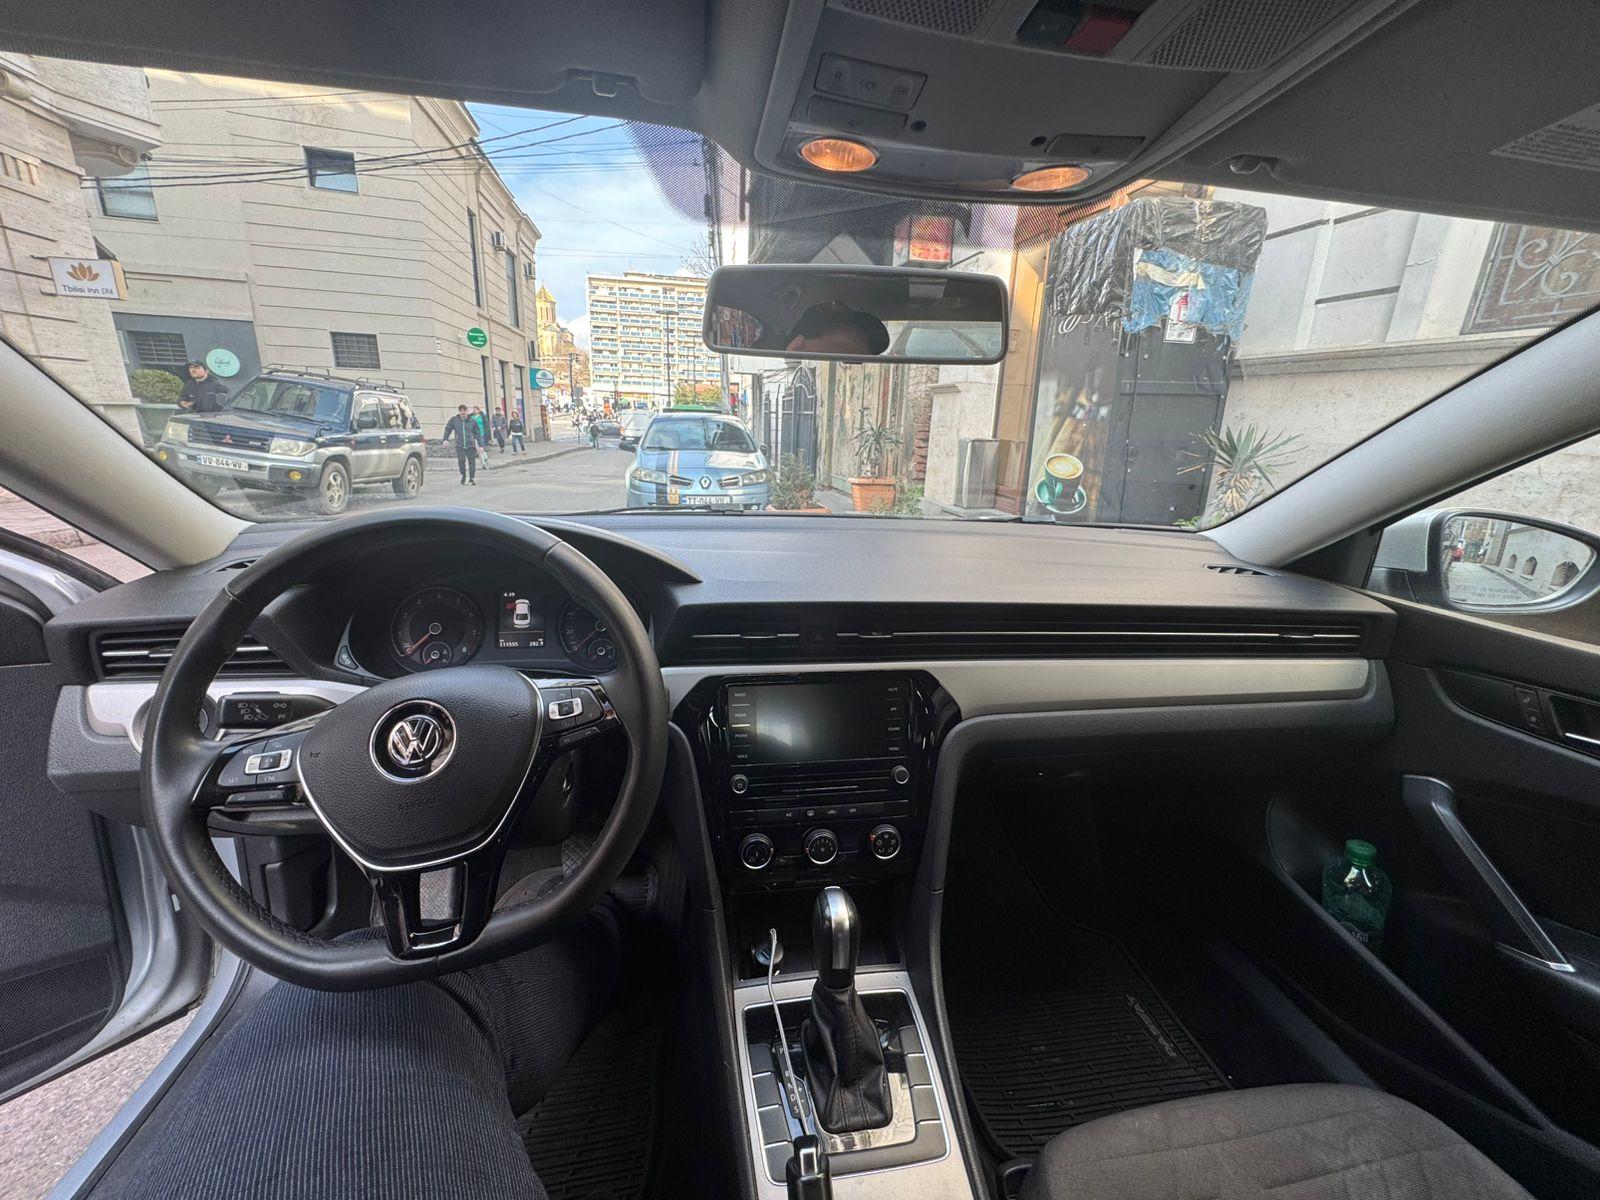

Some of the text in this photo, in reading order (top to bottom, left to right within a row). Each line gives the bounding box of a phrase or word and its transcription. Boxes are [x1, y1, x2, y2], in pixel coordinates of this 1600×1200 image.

[62, 284, 114, 295] Tbilisi Inn SPA
[790, 1093, 796, 1101] D
[793, 1105, 799, 1114] S
